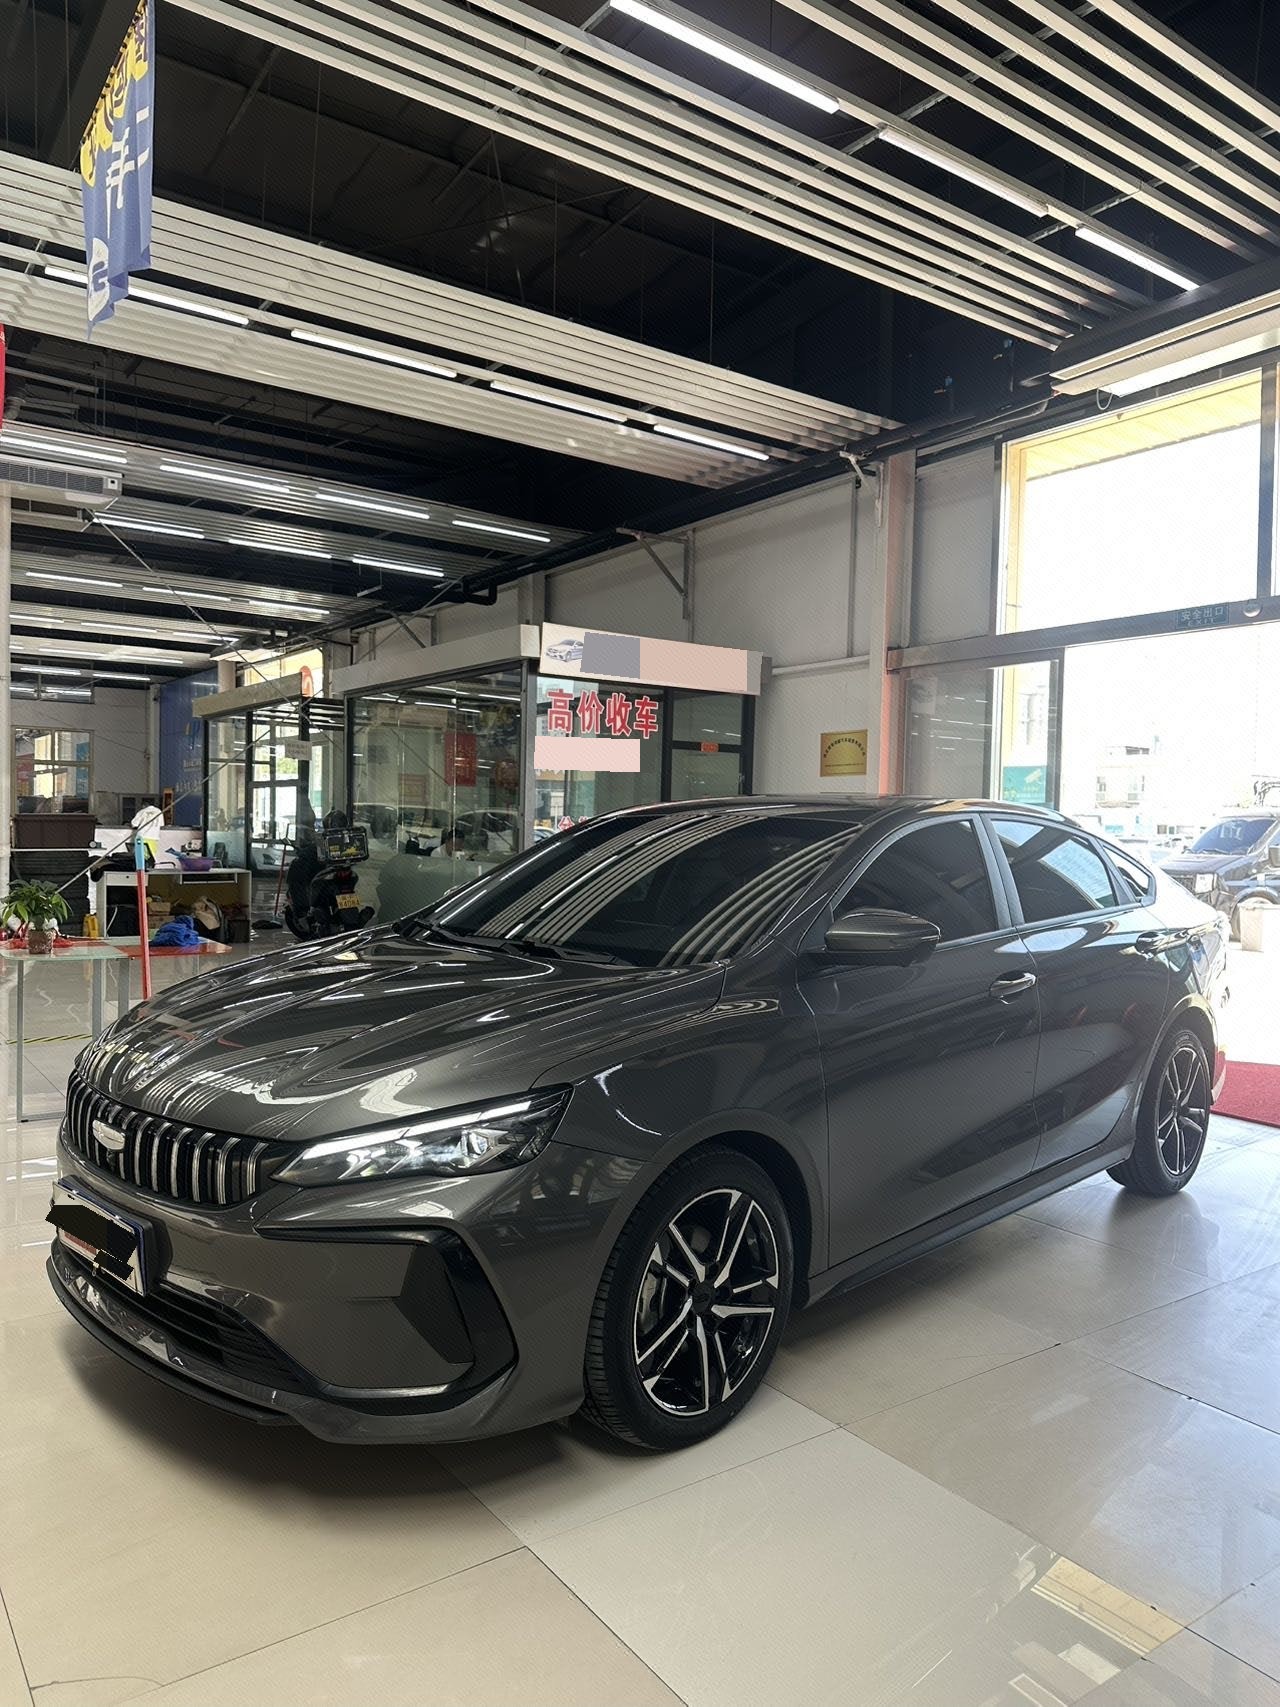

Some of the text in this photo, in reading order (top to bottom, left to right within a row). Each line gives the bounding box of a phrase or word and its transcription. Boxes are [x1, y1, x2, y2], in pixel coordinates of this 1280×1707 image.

[1181, 606, 1224, 621] 安全出口
[547, 688, 659, 739] 高价收车
